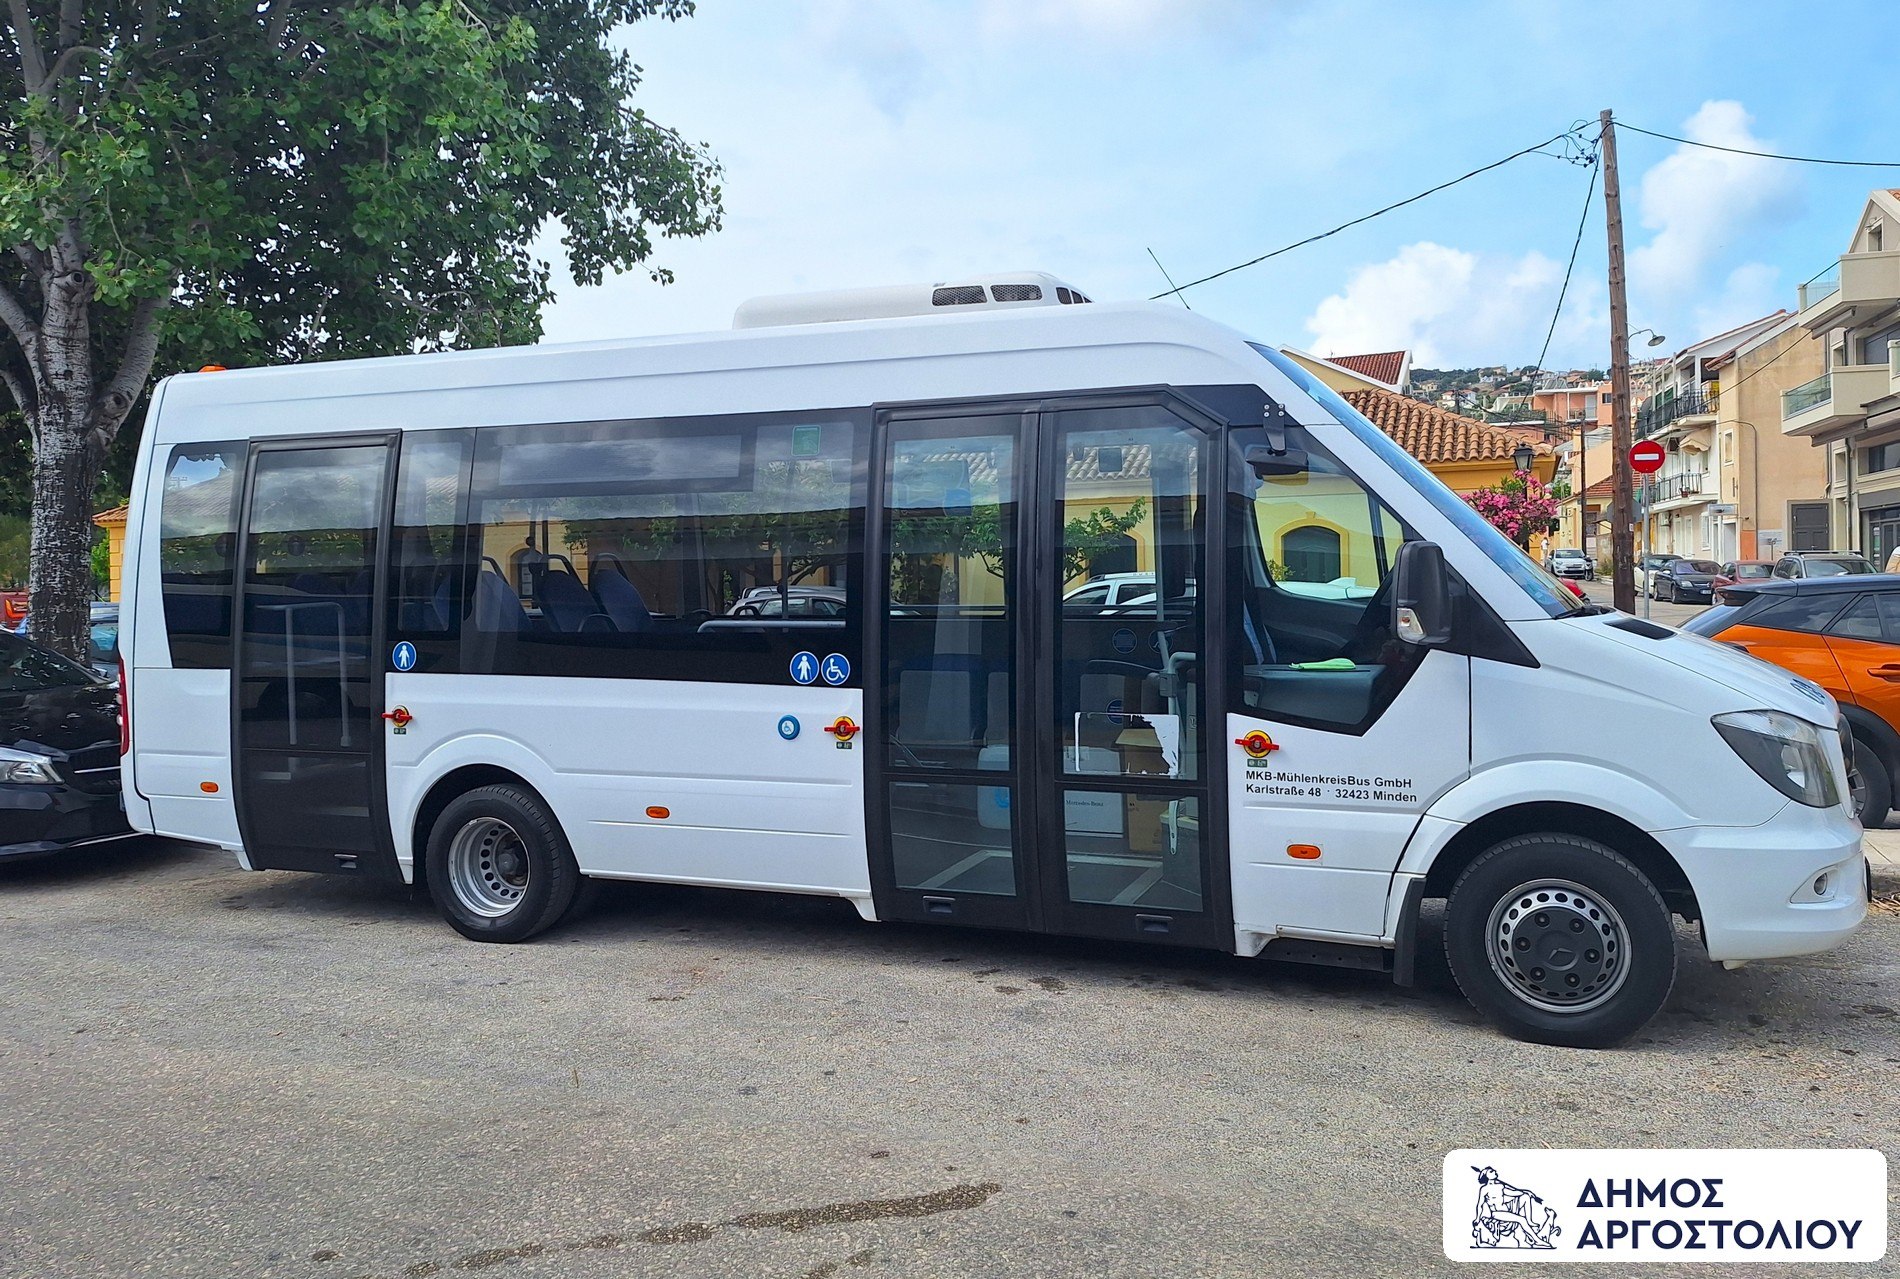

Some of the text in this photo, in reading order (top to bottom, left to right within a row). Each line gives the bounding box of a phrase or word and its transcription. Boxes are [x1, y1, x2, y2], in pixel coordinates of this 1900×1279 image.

[1246, 771, 1412, 788] MKB-MühlenkreisBus GmbH
[1246, 784, 1417, 802] Karlstraße 48 32423 Minden
